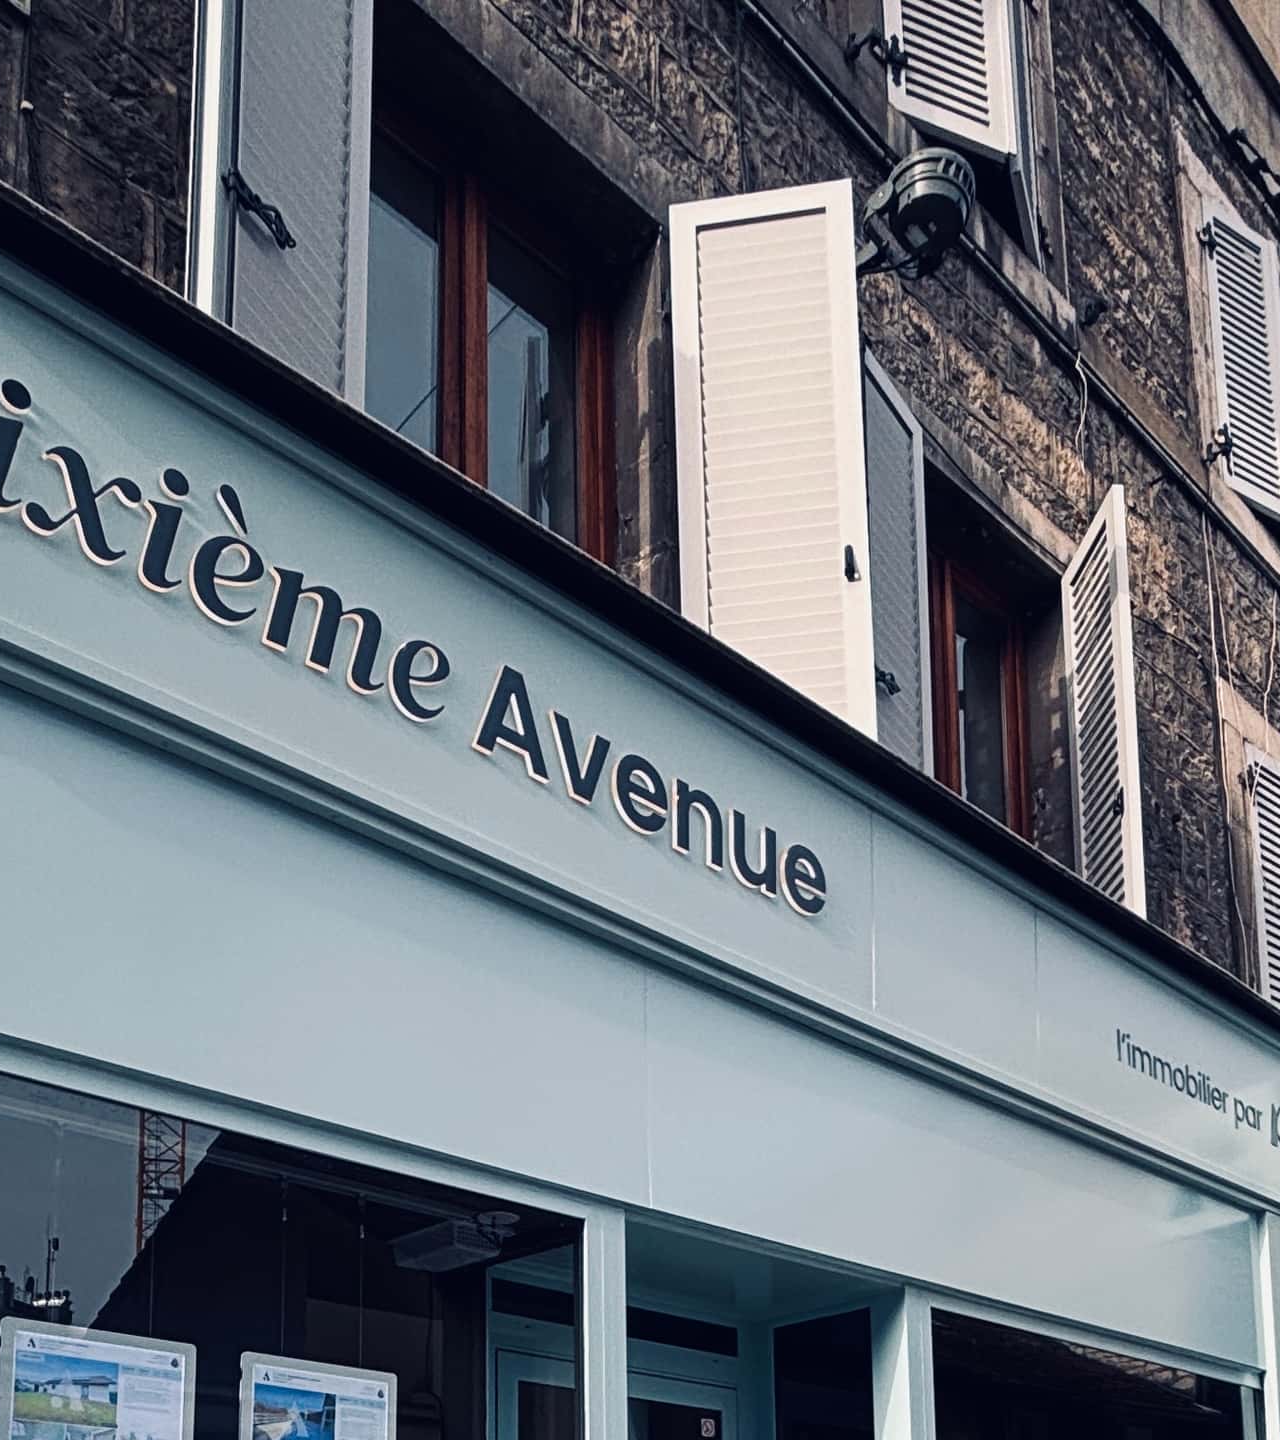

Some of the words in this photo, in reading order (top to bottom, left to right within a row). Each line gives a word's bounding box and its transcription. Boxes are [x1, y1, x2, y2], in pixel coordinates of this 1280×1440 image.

[472, 664, 828, 917] Avenue
[1116, 1028, 1229, 1113] l'immobilier
[1233, 1096, 1263, 1131] par
